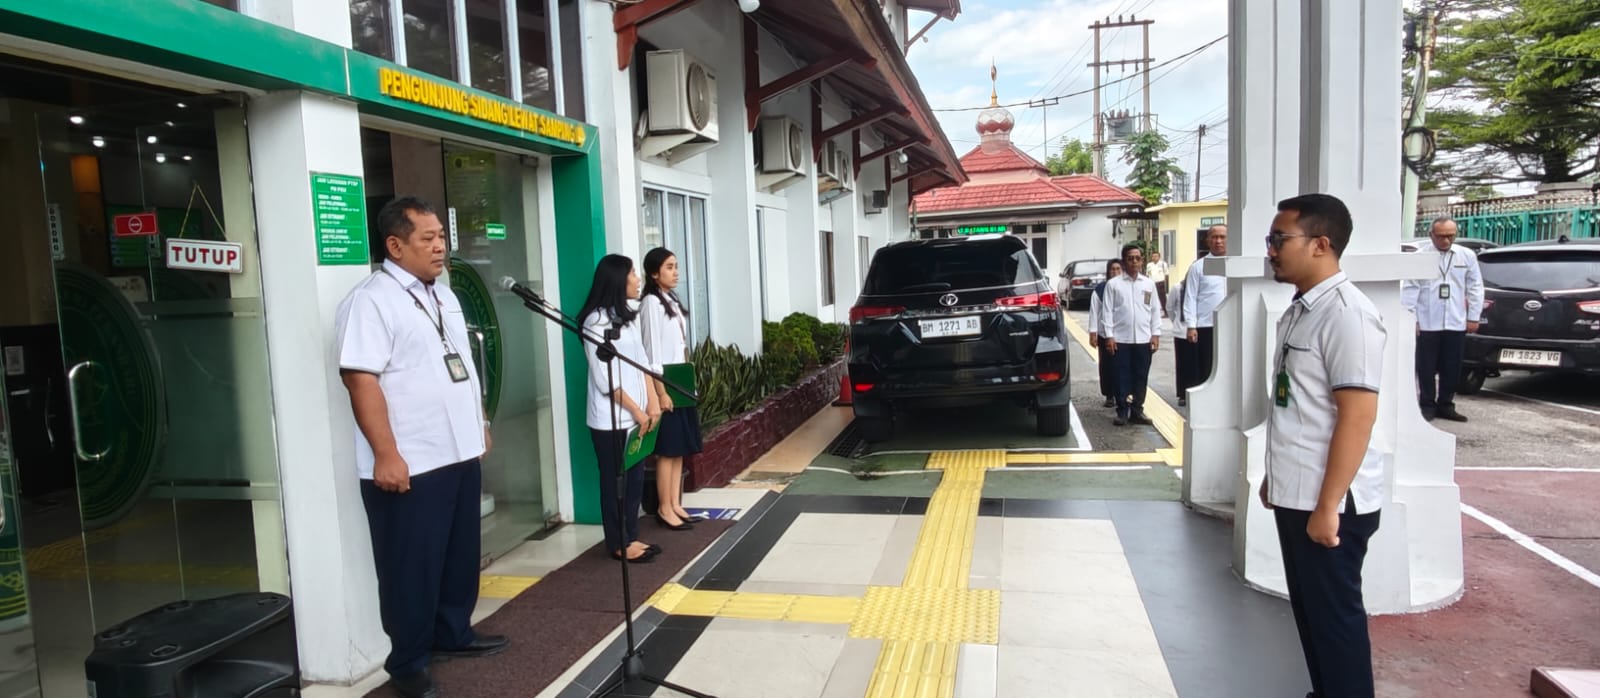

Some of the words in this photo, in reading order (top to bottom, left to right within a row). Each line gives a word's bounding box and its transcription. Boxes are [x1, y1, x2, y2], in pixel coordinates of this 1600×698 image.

[379, 67, 469, 115] PENGUNJUNG
[470, 93, 508, 126] SIDANG
[510, 106, 538, 132] LEWAT
[540, 115, 575, 143] SAMPING
[172, 246, 237, 266] TUTUP
[922, 323, 933, 333] BM
[940, 321, 961, 332] 1271
[966, 319, 978, 329] AB
[1502, 349, 1514, 358] BM
[1547, 352, 1559, 361] VG
